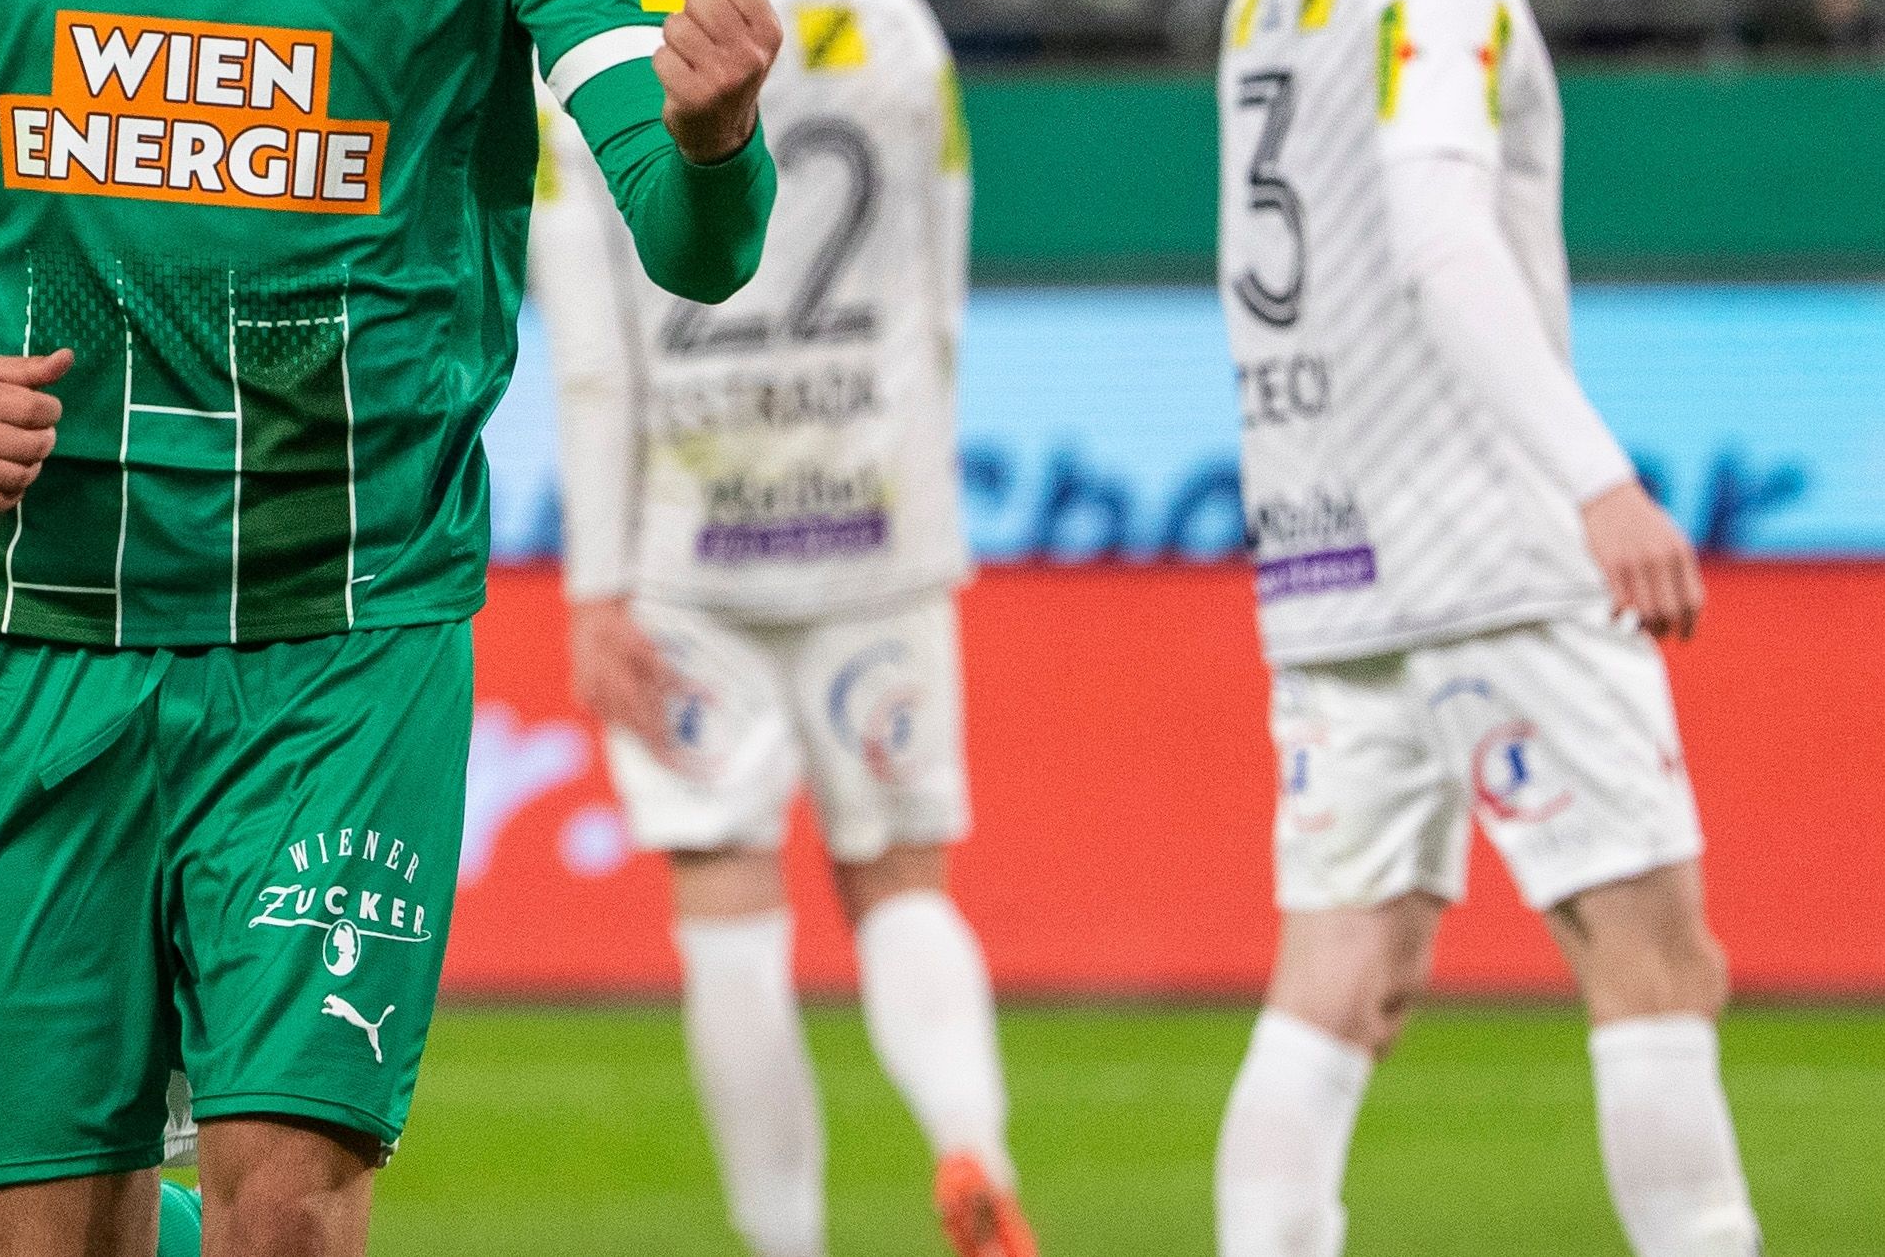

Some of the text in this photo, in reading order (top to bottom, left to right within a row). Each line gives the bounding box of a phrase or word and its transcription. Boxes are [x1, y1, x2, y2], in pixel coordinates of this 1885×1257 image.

[69, 24, 317, 114] WIEN
[12, 106, 374, 201] ENERGIE
[288, 828, 420, 884] WIENER
[248, 884, 431, 942] ZUCKER
